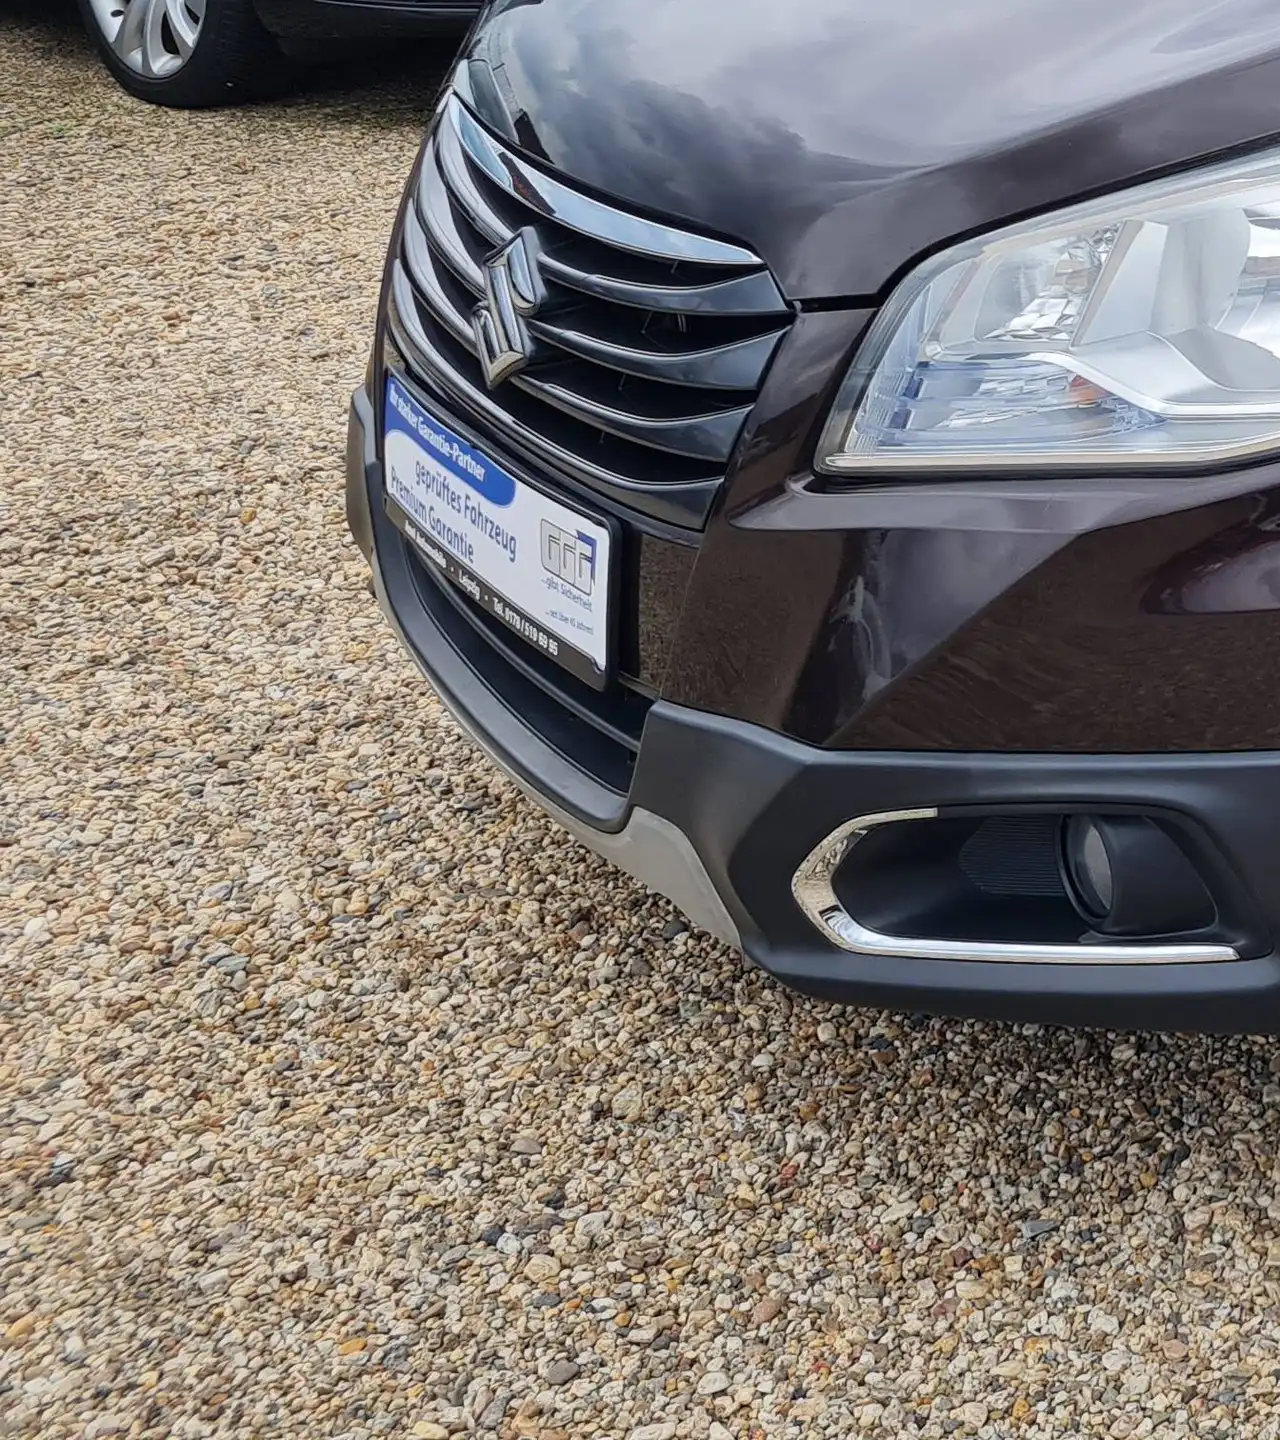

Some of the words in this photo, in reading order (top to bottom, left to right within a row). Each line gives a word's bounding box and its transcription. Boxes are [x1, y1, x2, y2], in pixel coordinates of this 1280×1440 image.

[417, 415, 486, 482] Garantie-Partner
[390, 464, 428, 525] Premium
[428, 506, 475, 564] Garantie
[415, 460, 463, 514] geprüftes
[464, 494, 518, 563] Fahrzeug
